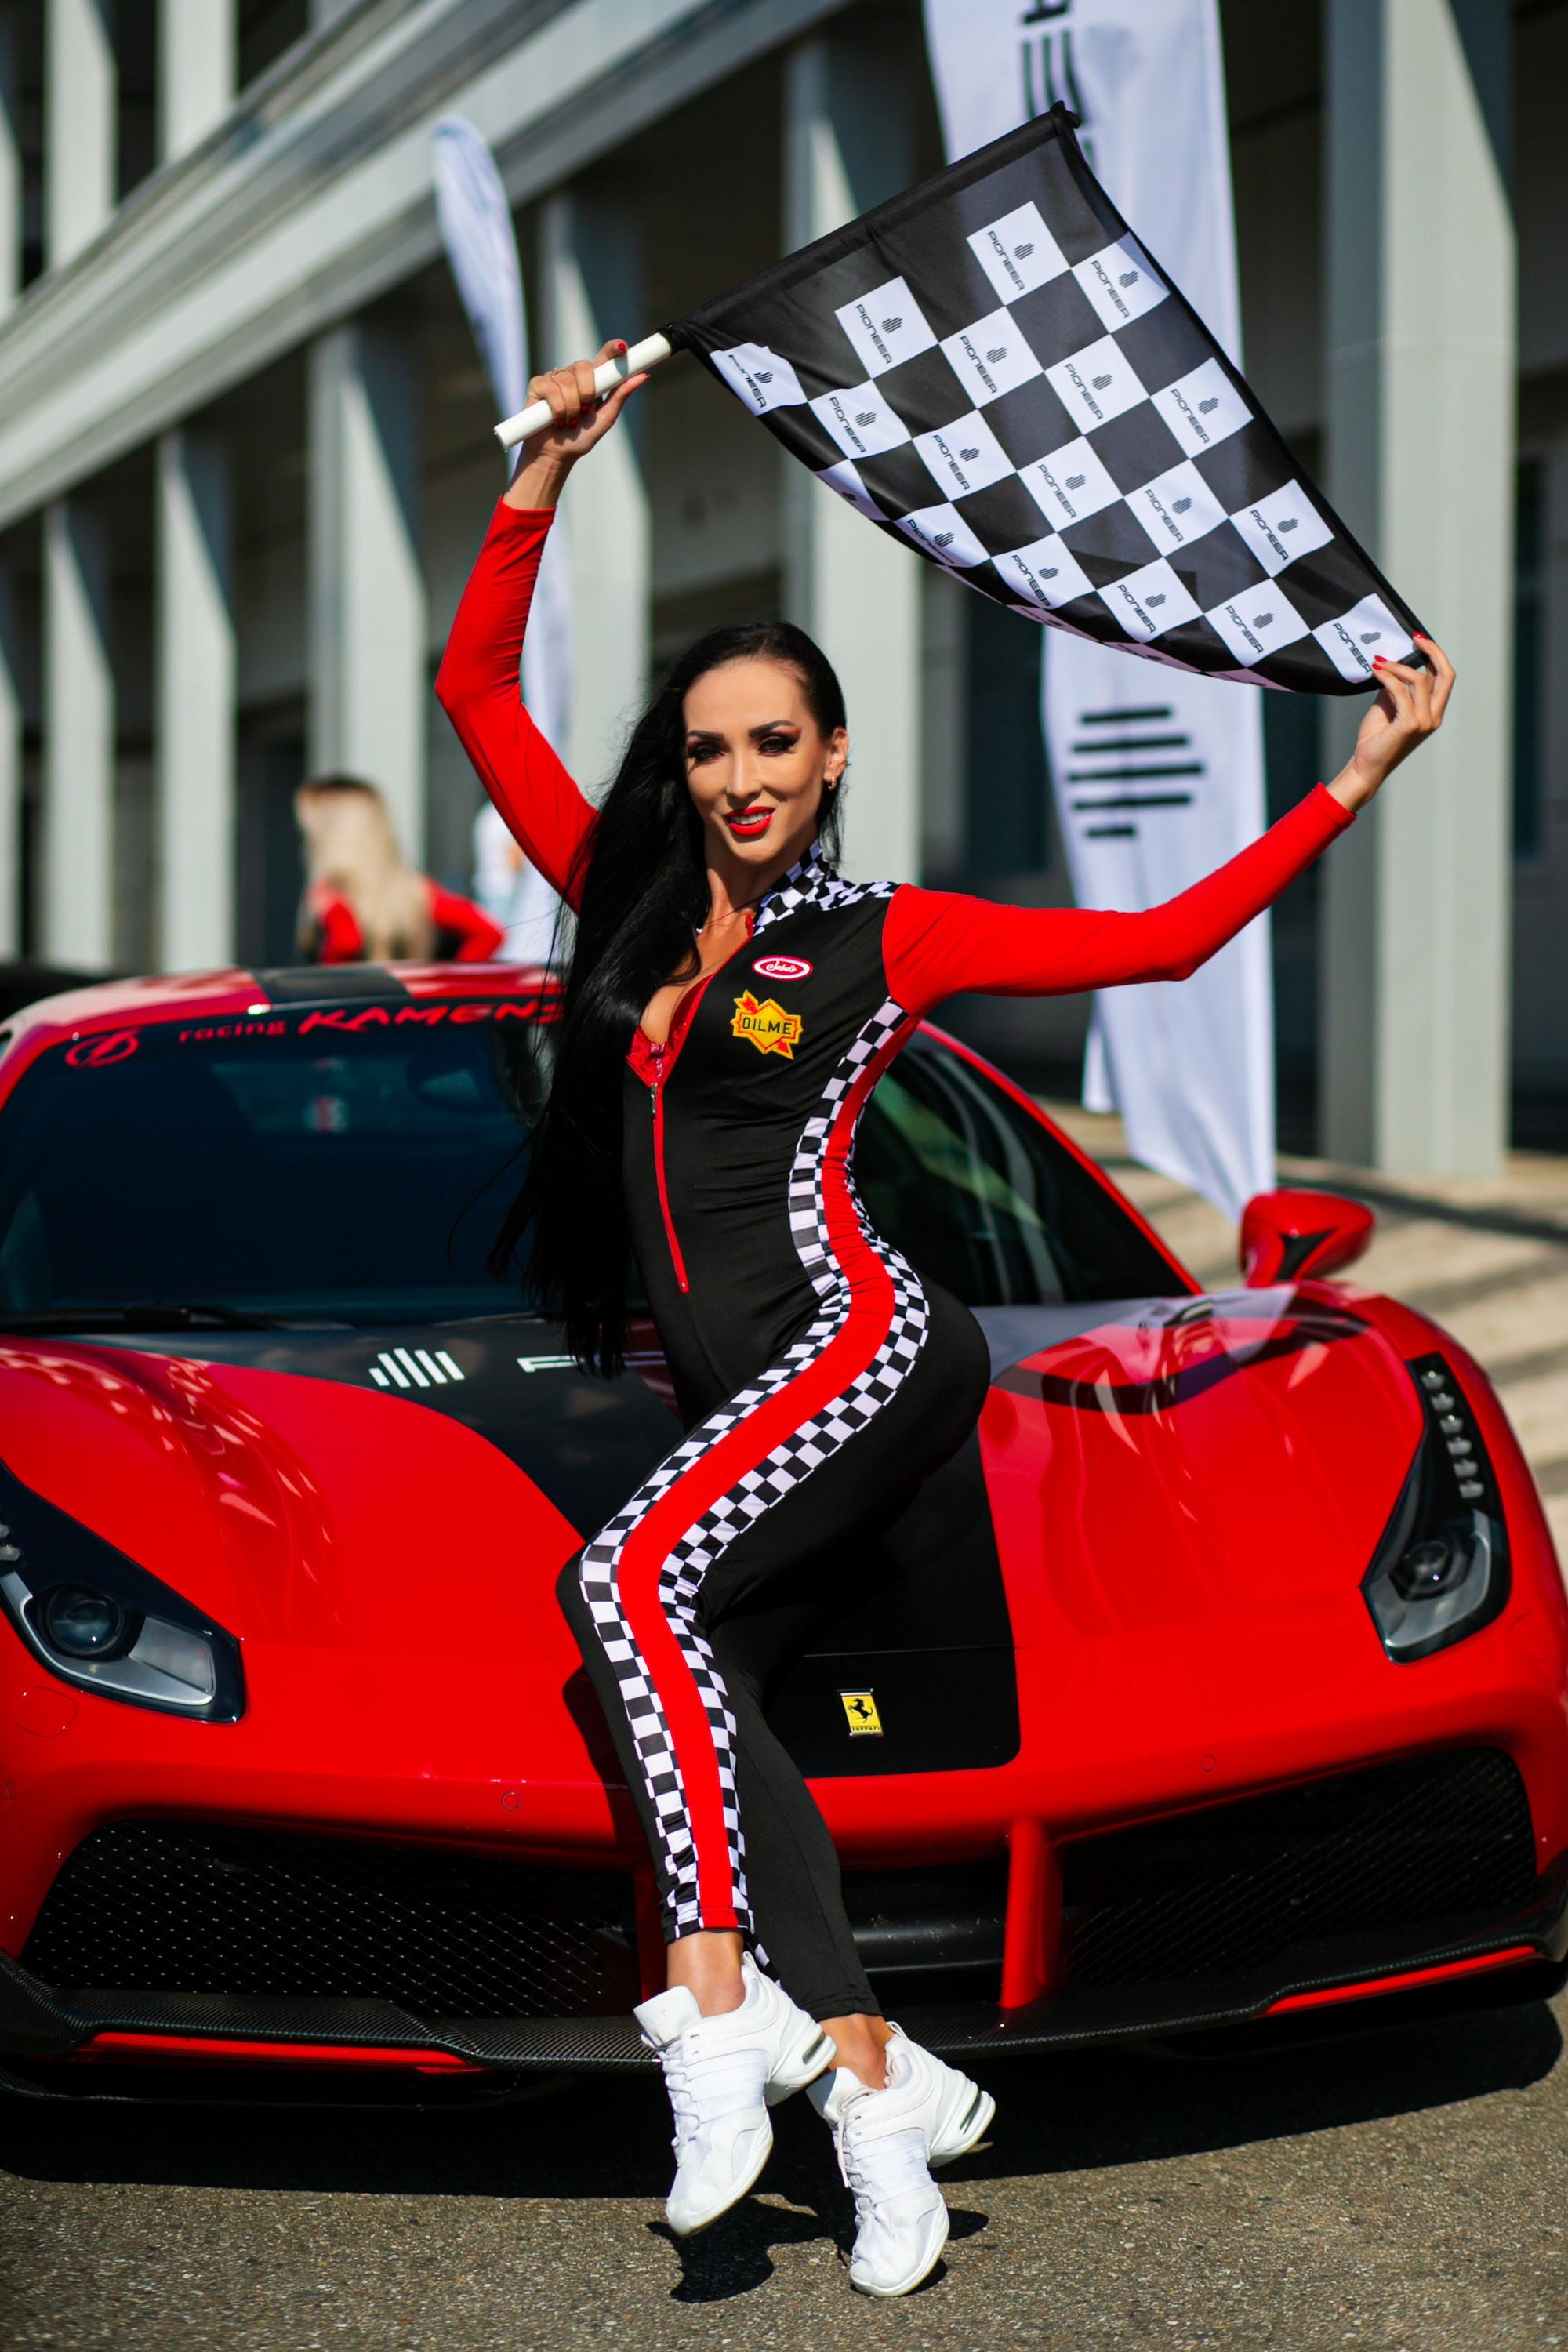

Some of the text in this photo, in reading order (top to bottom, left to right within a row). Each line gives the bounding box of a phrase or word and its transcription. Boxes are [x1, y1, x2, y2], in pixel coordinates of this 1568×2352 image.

[987, 230, 1025, 291] PIONEER
[1091, 260, 1130, 318] PIONEER
[855, 303, 892, 364] PIONEER
[960, 336, 998, 394] PIONEER
[1064, 363, 1103, 420] PIONEER
[829, 397, 866, 452] PIONEER
[1171, 388, 1210, 444] PIONEER
[932, 434, 971, 490] PIONEER
[1038, 464, 1077, 518] PIONEER
[1145, 488, 1184, 543] PIONEER
[1250, 510, 1289, 561] PIONEER
[1117, 584, 1156, 633] PIONEER
[1225, 605, 1264, 654] PIONEER
[1333, 622, 1372, 673] PIONEER
[179, 1020, 286, 1044] racing
